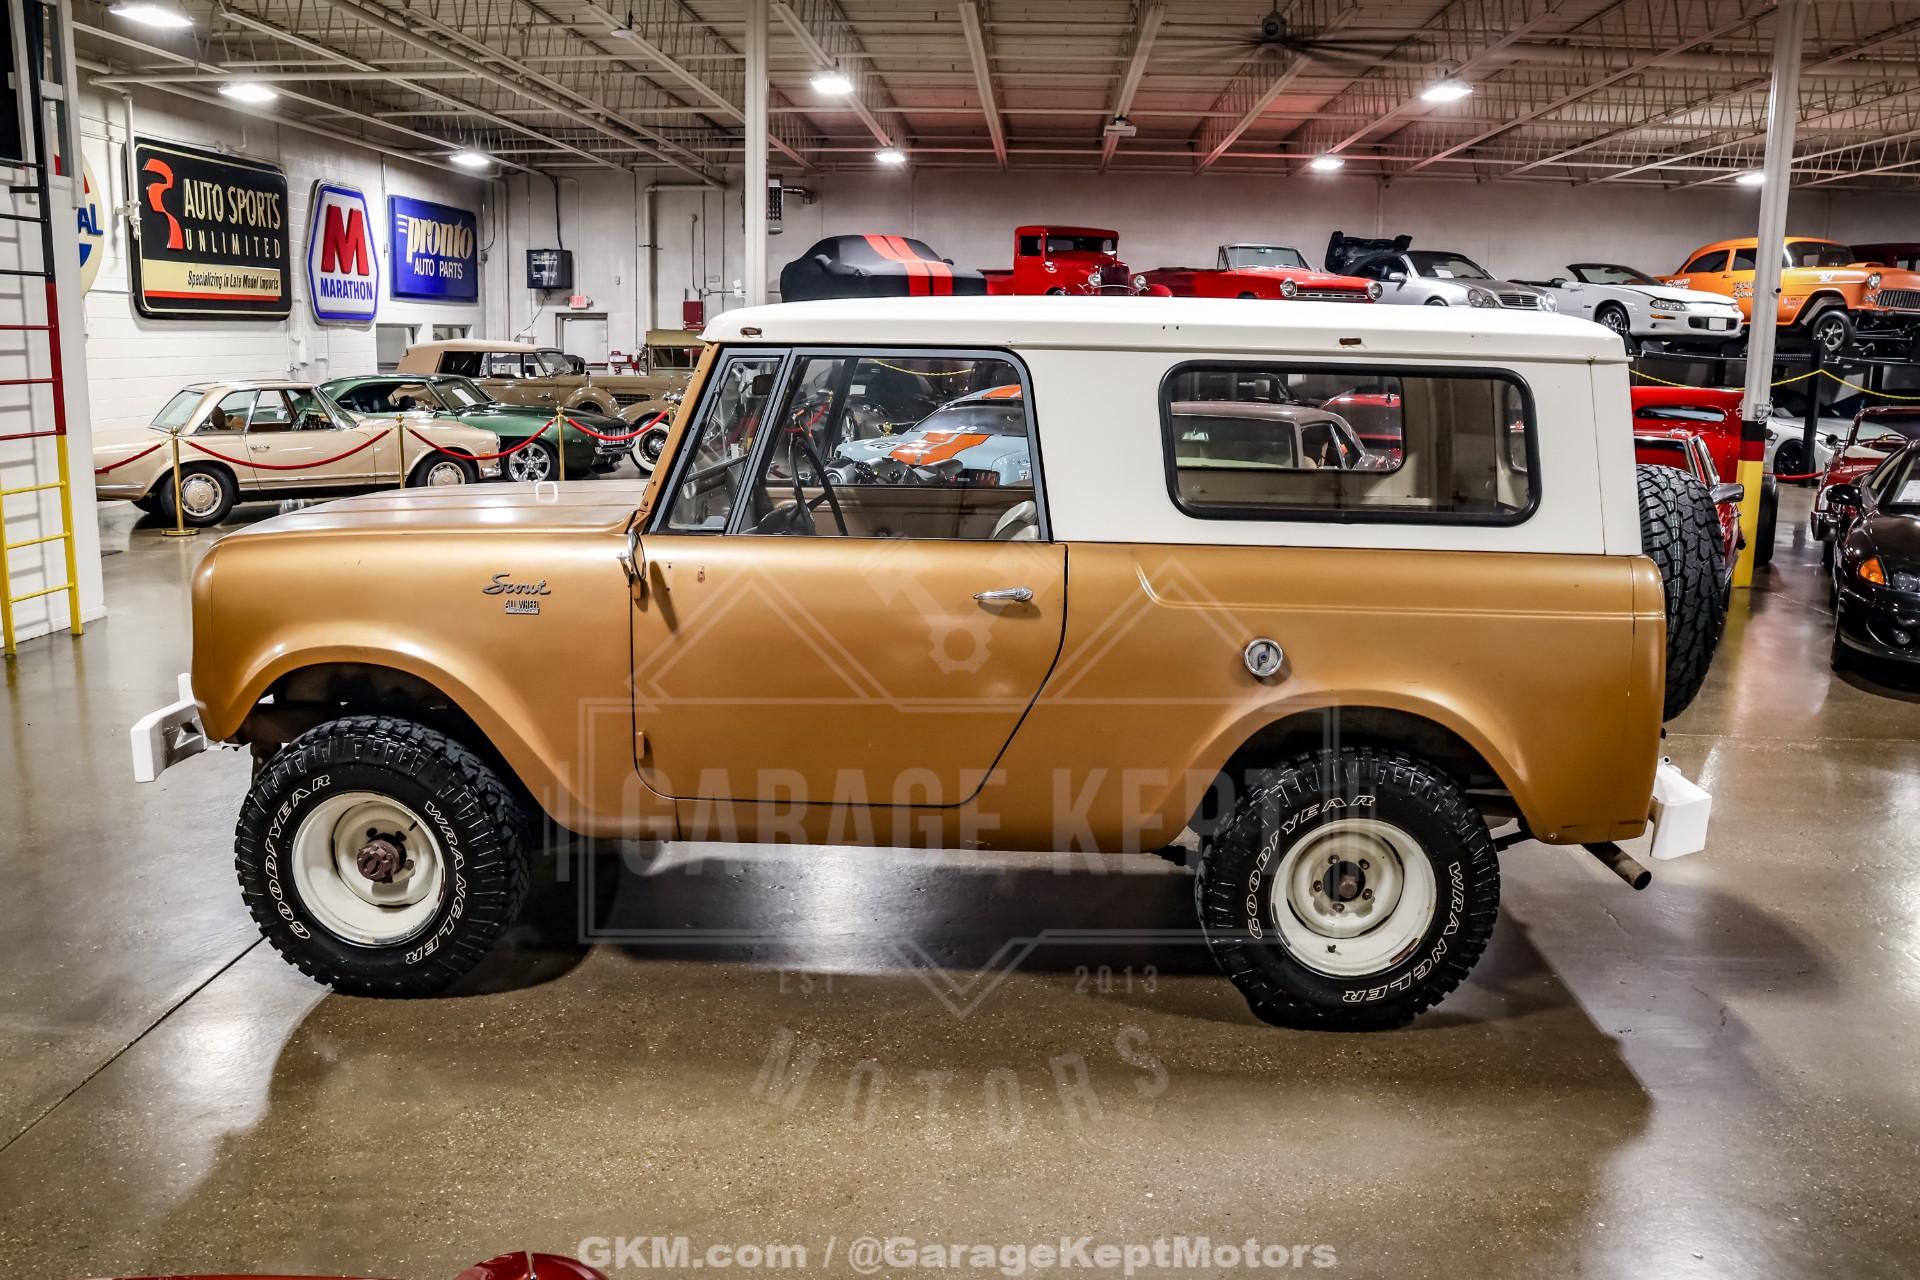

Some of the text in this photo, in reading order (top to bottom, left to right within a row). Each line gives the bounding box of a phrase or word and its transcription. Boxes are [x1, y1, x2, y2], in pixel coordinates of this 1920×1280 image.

[184, 178, 281, 230] AUTO SPORTS
[185, 228, 280, 259] UNLIMITED
[321, 204, 369, 276] M
[405, 216, 474, 263] pronto
[187, 270, 222, 289] Specializing
[229, 273, 242, 288] Late
[242, 274, 259, 289] Model
[414, 257, 463, 280] AUTO PARTS
[320, 277, 373, 300] MARATHON
[572, 295, 586, 307] EXIT
[482, 572, 551, 595] Scout
[518, 599, 540, 609] WHEEL
[263, 774, 331, 940] GOODYEAR
[1246, 795, 1376, 940] GOODYEAR
[404, 800, 467, 965] WRANGLER
[1342, 861, 1465, 1003] WRANGLER
